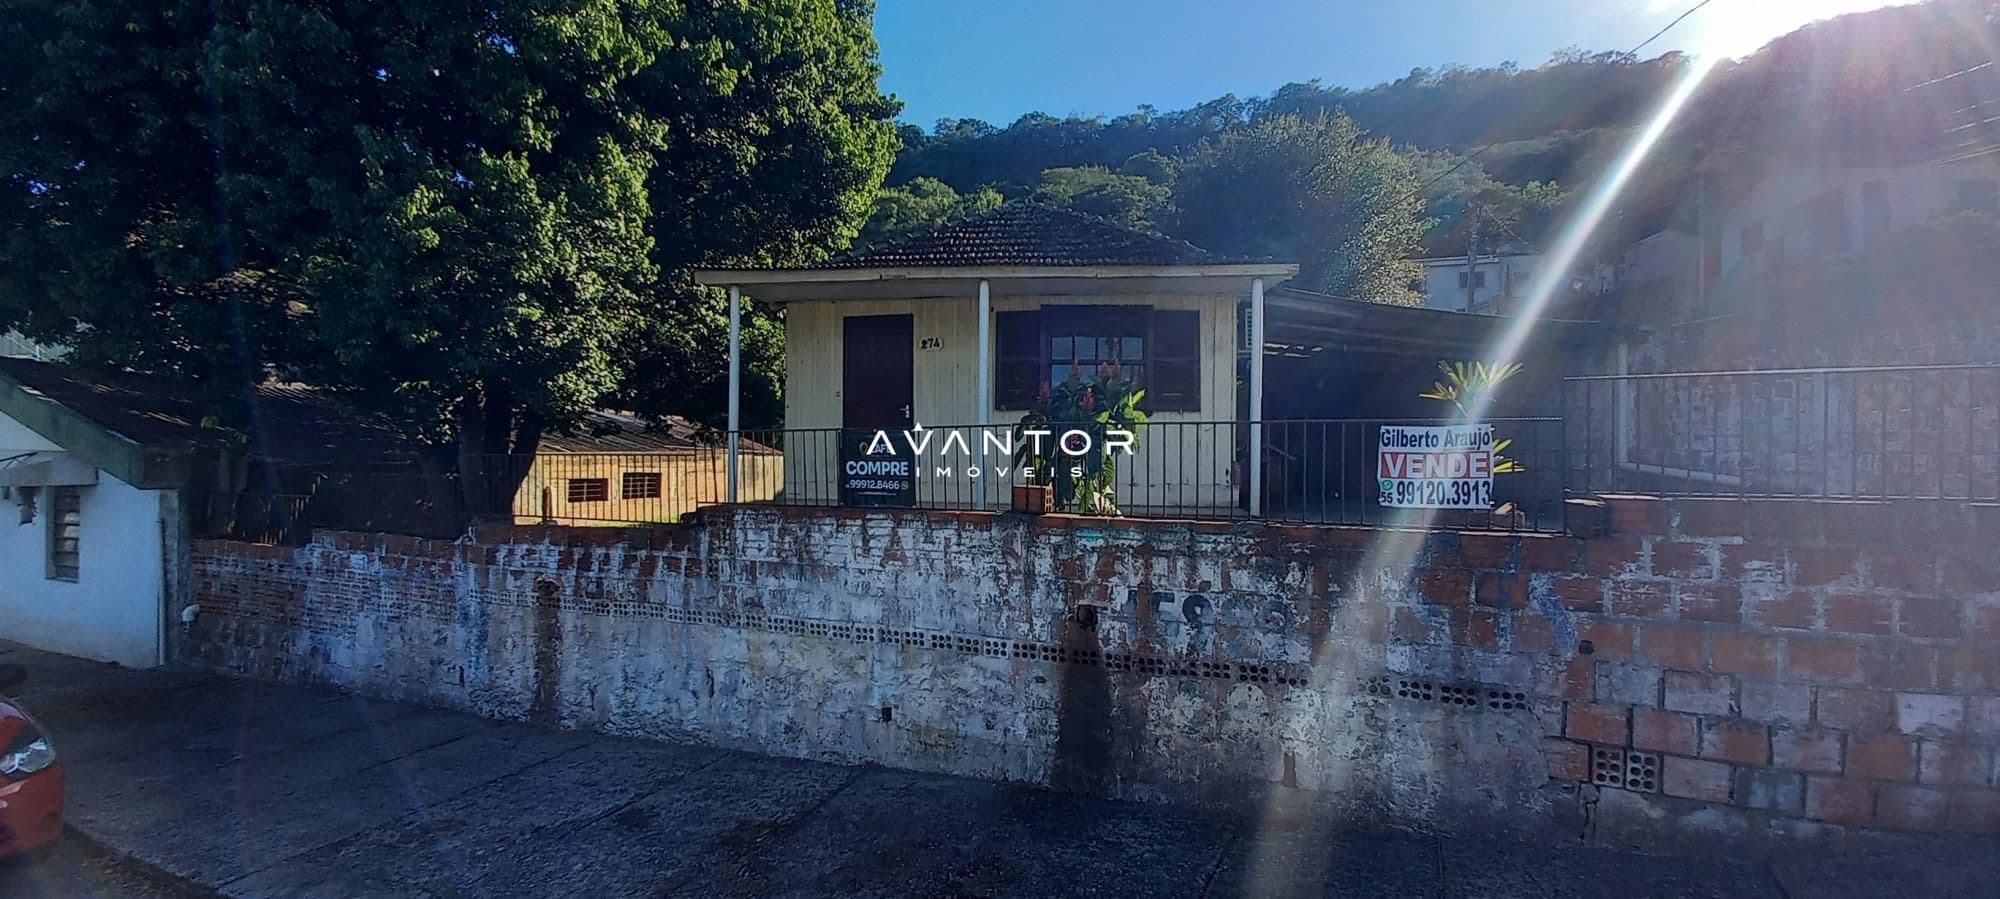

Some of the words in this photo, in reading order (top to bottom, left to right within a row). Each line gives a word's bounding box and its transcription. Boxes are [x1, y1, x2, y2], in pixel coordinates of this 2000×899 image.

[921, 337, 941, 350] 274
[1381, 428, 1439, 448] Gilberto
[1444, 427, 1491, 450] Araujo
[846, 460, 909, 476] COMPRE
[1384, 453, 1489, 478] VENDE
[1380, 491, 1394, 504] 55
[1396, 480, 1491, 506] 99120.3913
